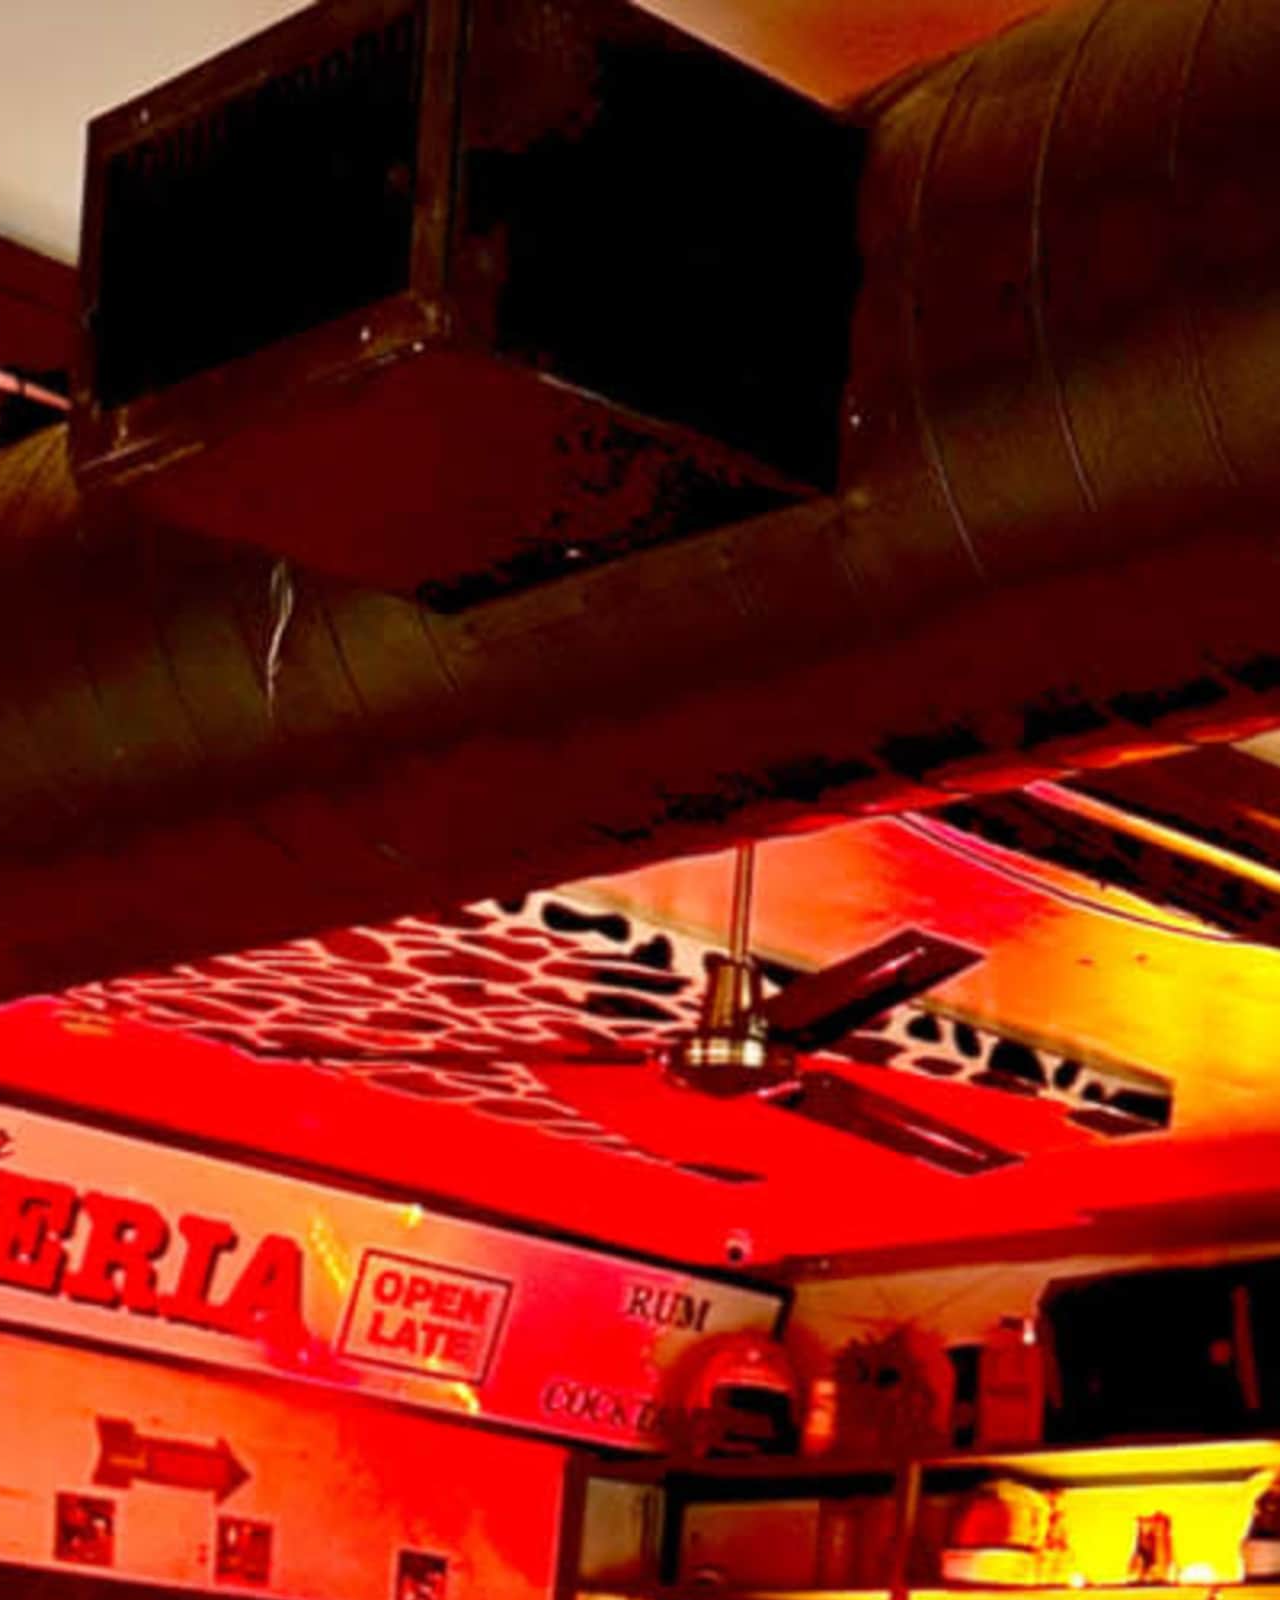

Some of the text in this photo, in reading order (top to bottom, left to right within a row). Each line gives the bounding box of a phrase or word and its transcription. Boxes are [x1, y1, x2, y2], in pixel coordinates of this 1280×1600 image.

[373, 1270, 493, 1326] OPEN
[626, 1284, 711, 1333] RUM
[368, 1311, 479, 1373] LATE
